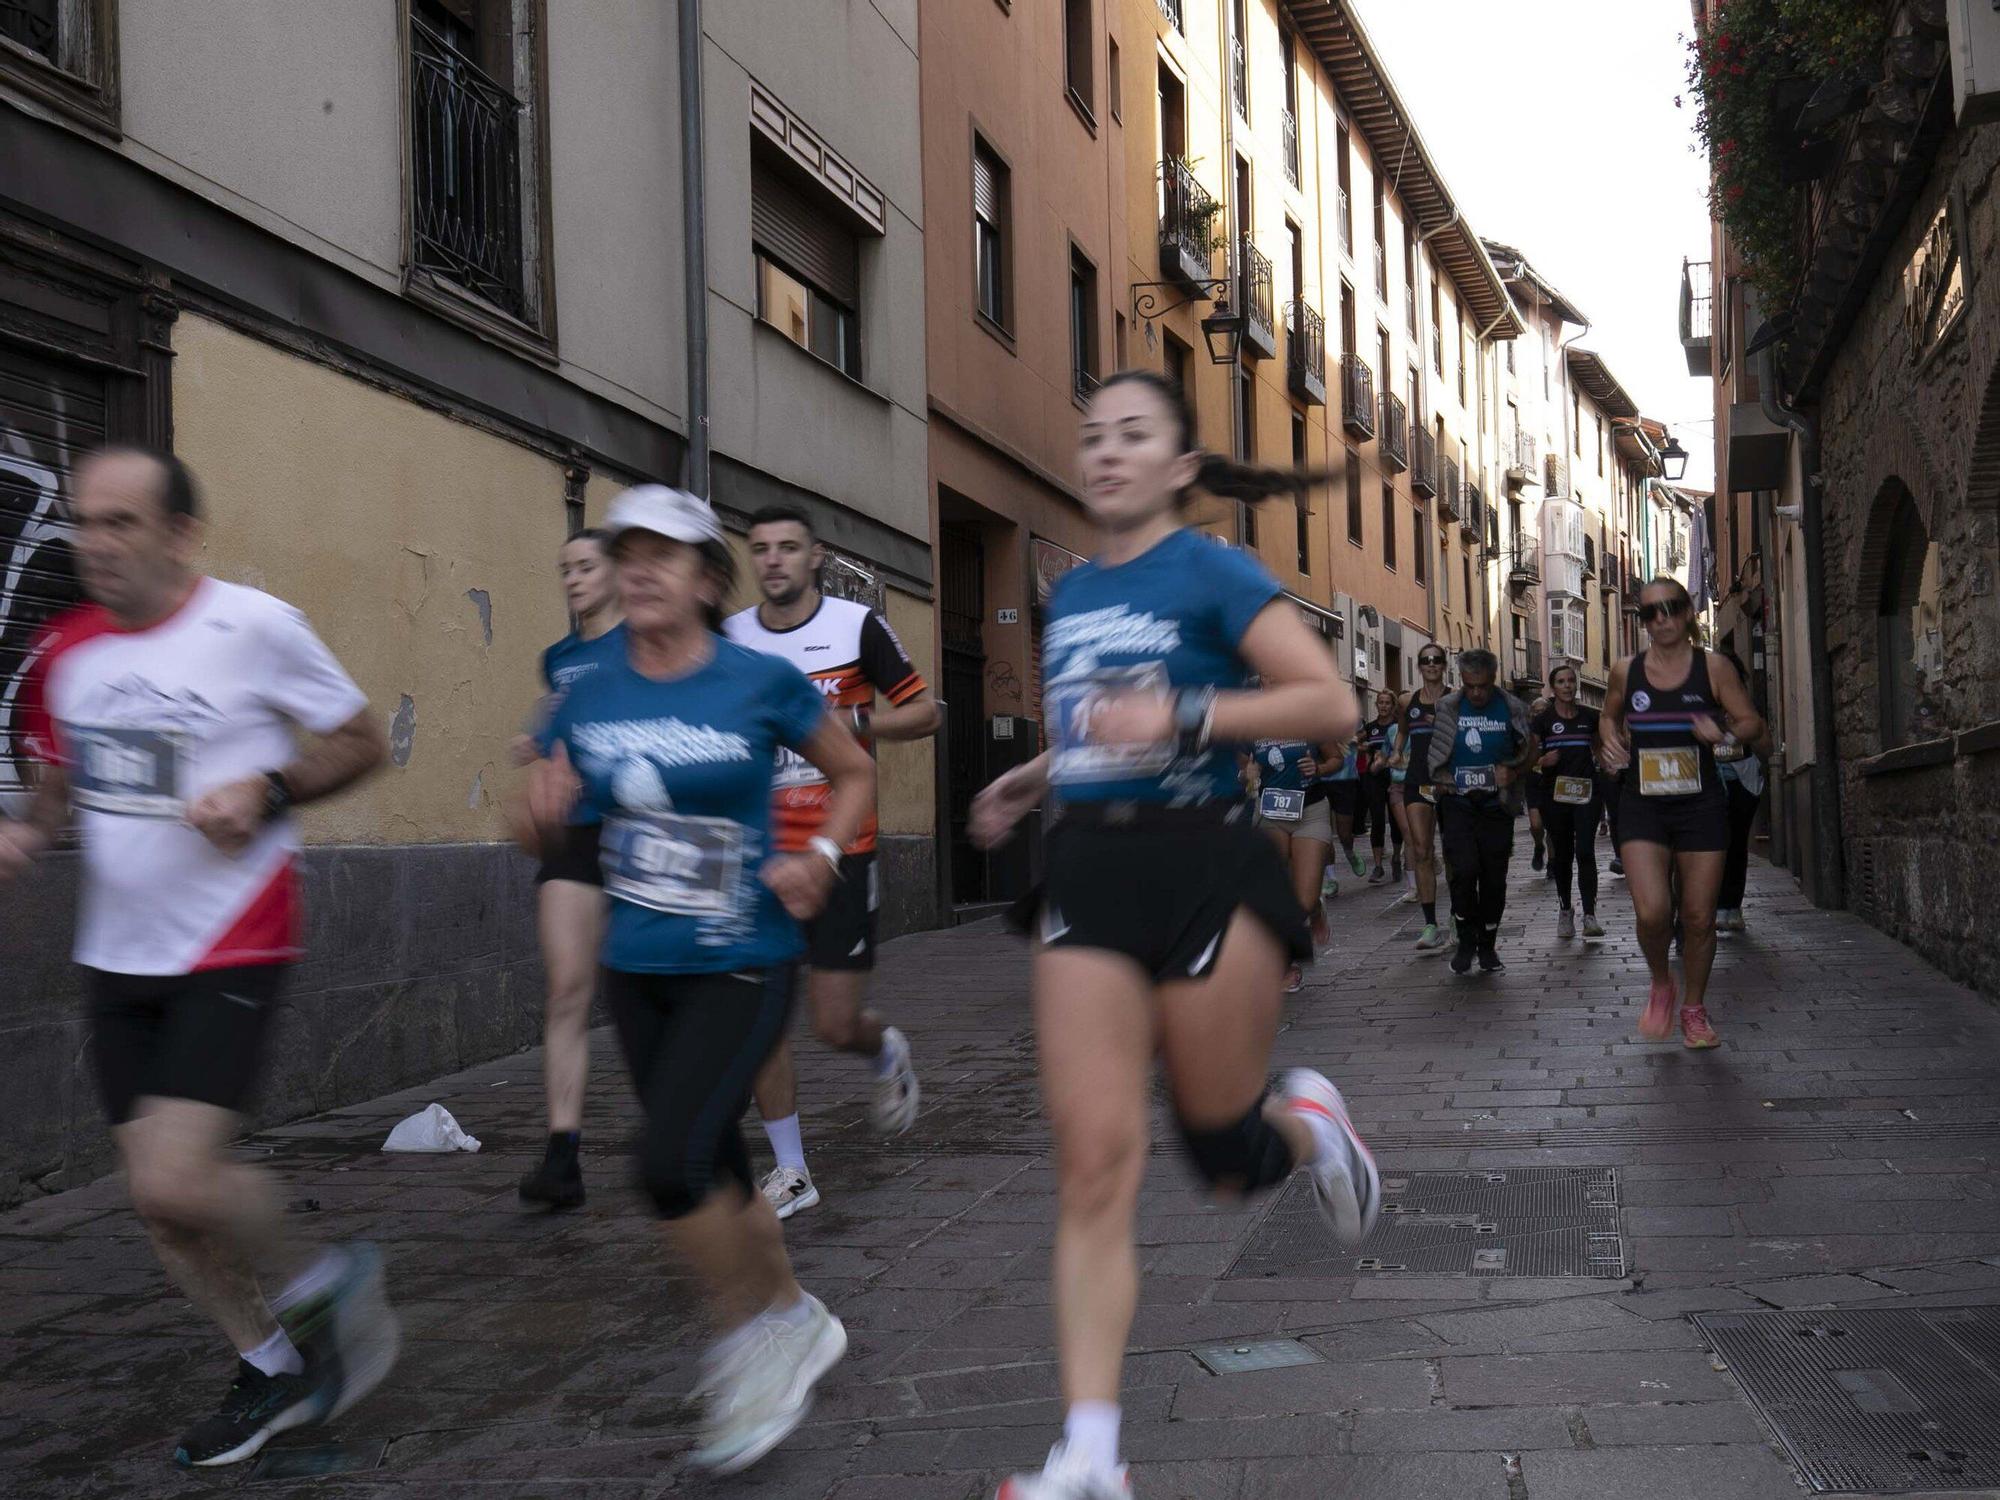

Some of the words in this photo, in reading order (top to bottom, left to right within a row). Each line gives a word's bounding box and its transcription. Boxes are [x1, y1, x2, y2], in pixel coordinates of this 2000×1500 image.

[1000, 611, 1017, 621] 46
[1464, 773, 1486, 785] 830
[1273, 795, 1292, 809] 787
